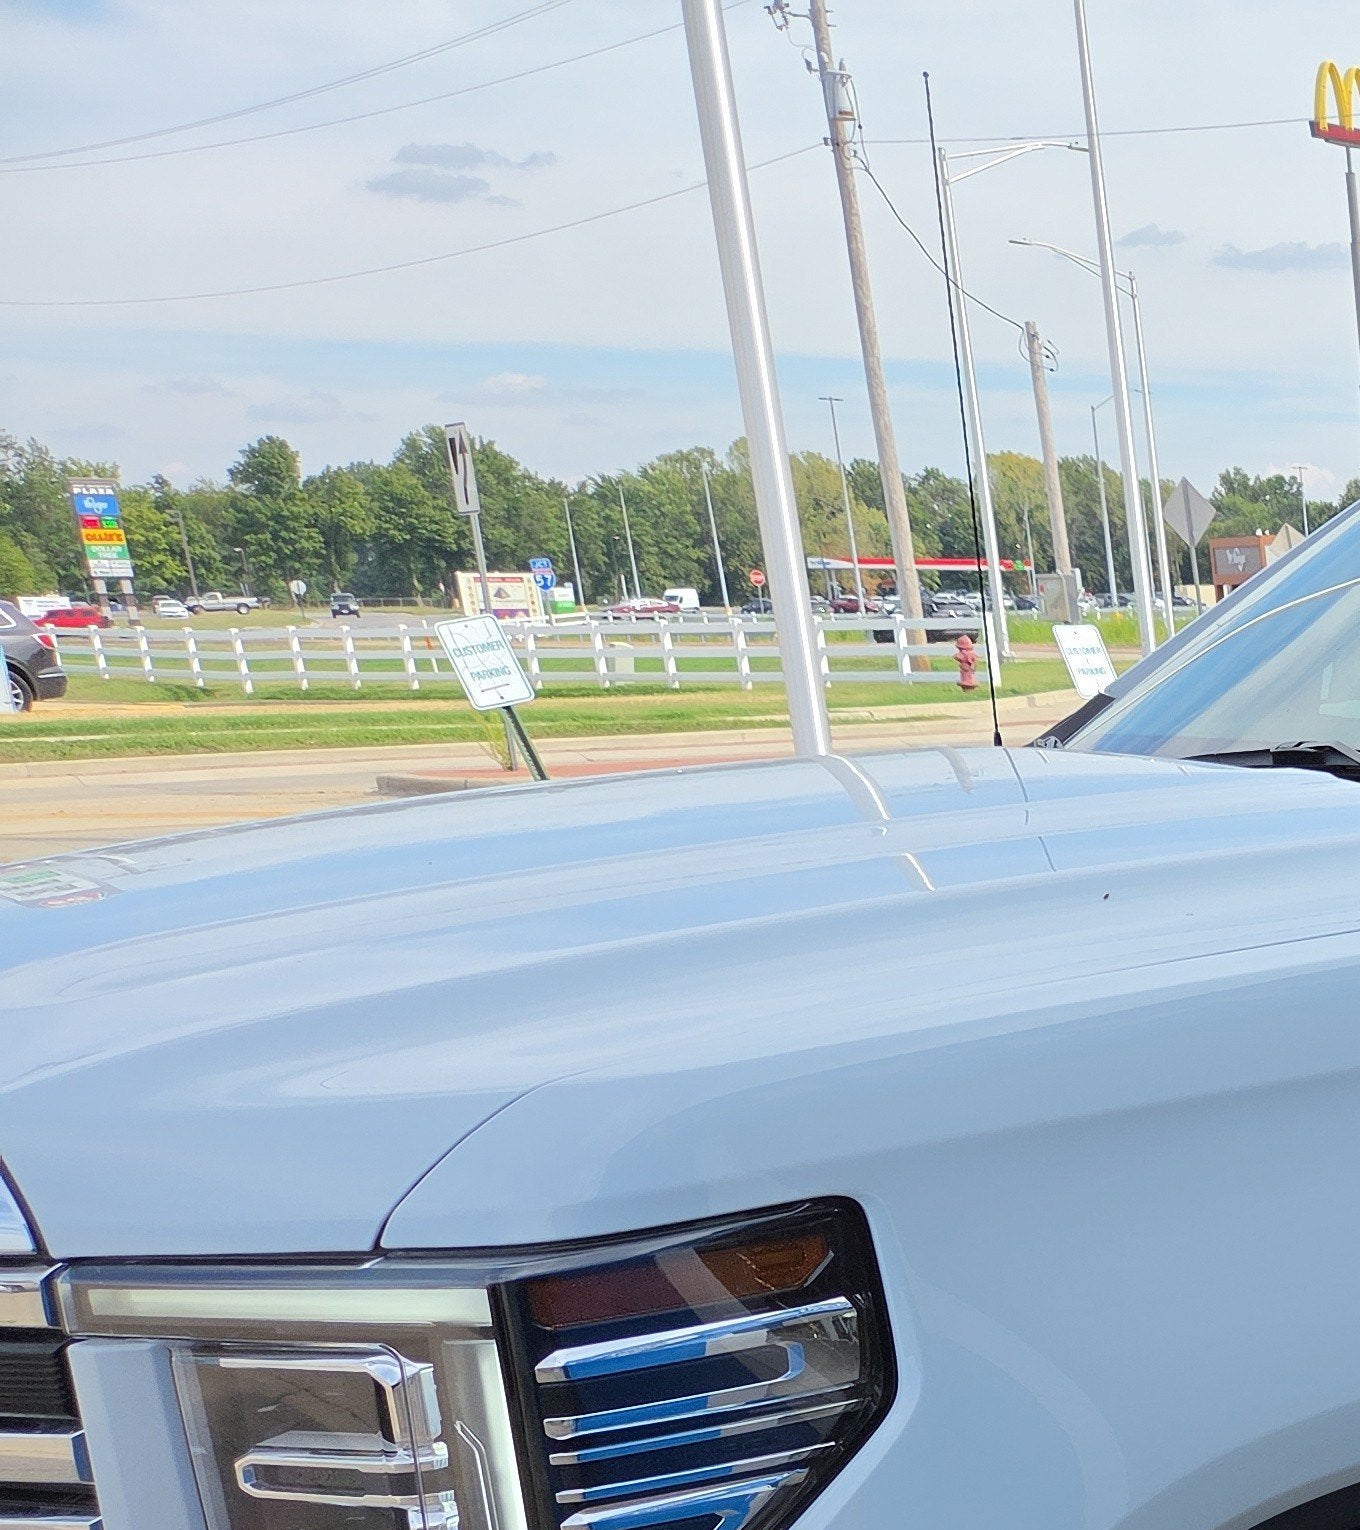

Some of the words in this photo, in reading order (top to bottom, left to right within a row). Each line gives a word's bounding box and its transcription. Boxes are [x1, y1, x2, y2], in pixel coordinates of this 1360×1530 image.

[534, 574, 552, 587] 57
[453, 640, 506, 658] CUSTOMER
[470, 665, 512, 682] PARKING
